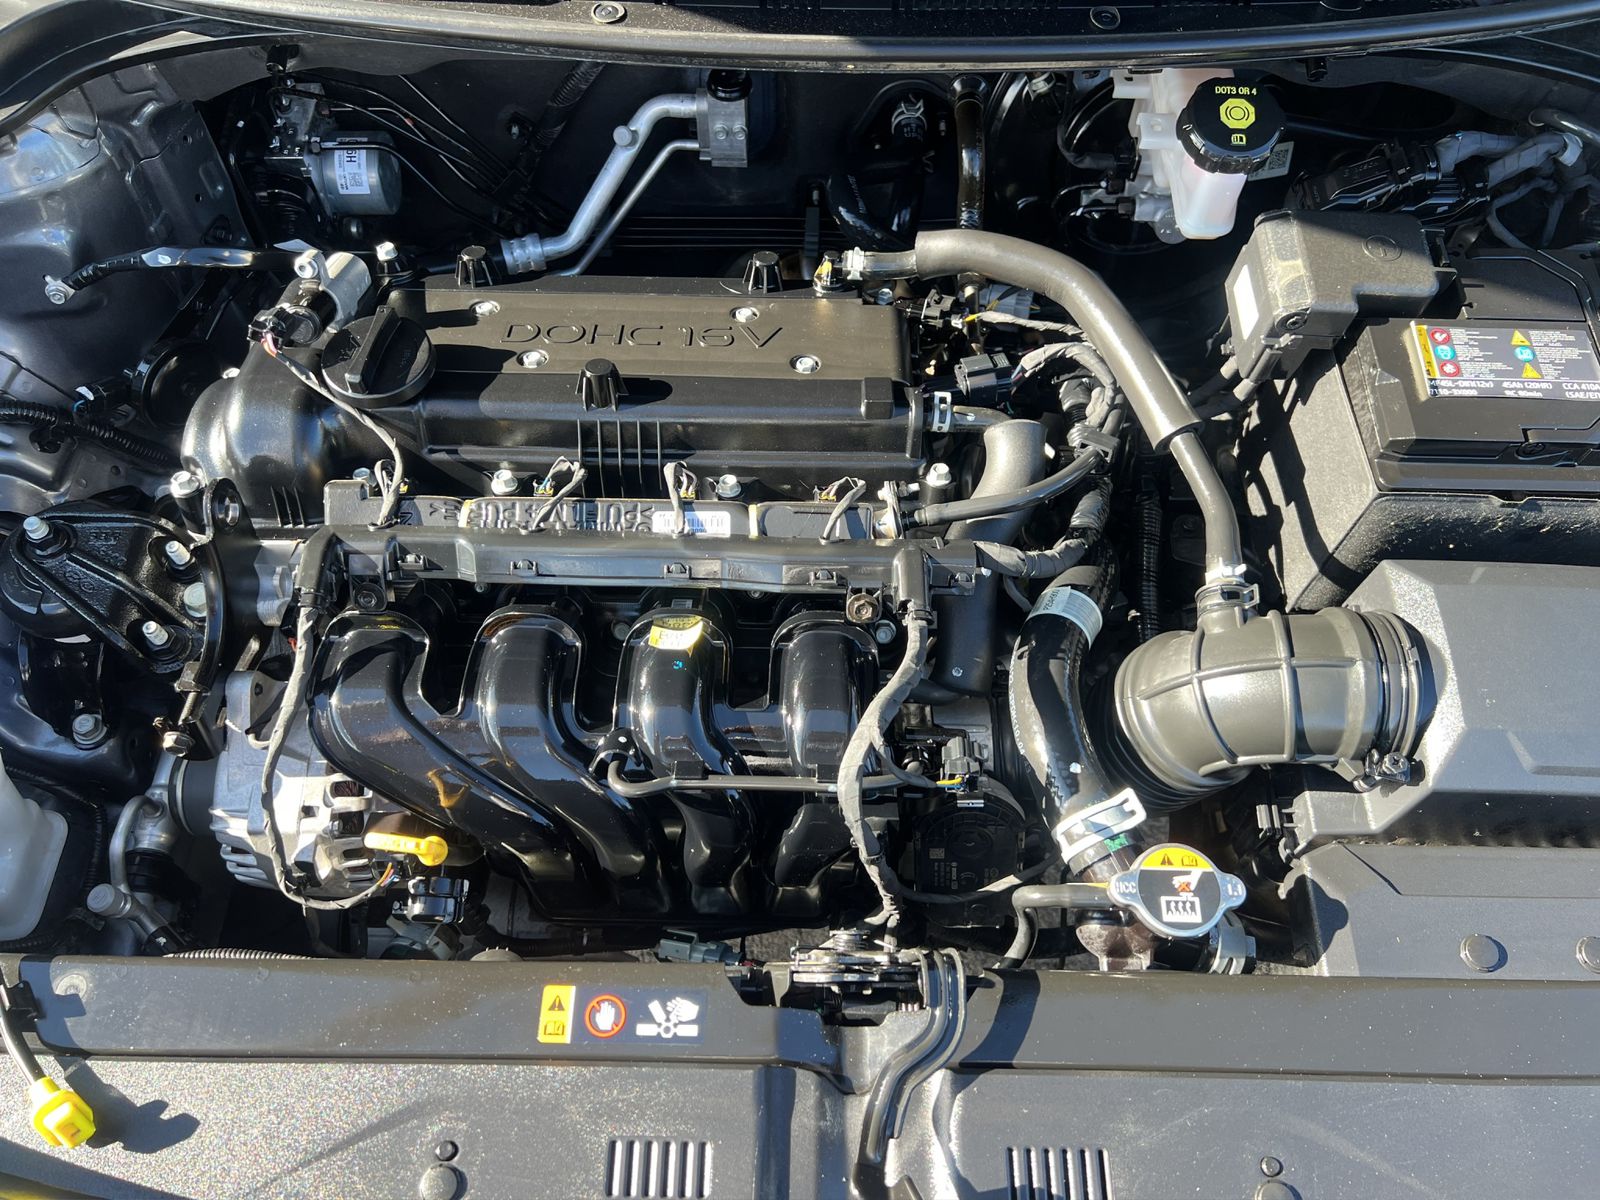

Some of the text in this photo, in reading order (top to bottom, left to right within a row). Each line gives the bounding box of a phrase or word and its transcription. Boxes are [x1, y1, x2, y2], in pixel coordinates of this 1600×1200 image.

[1215, 86, 1237, 95] DOT3
[1238, 87, 1250, 95] OR
[500, 324, 783, 348] DOHC 16V
[1562, 382, 1580, 390] CCA
